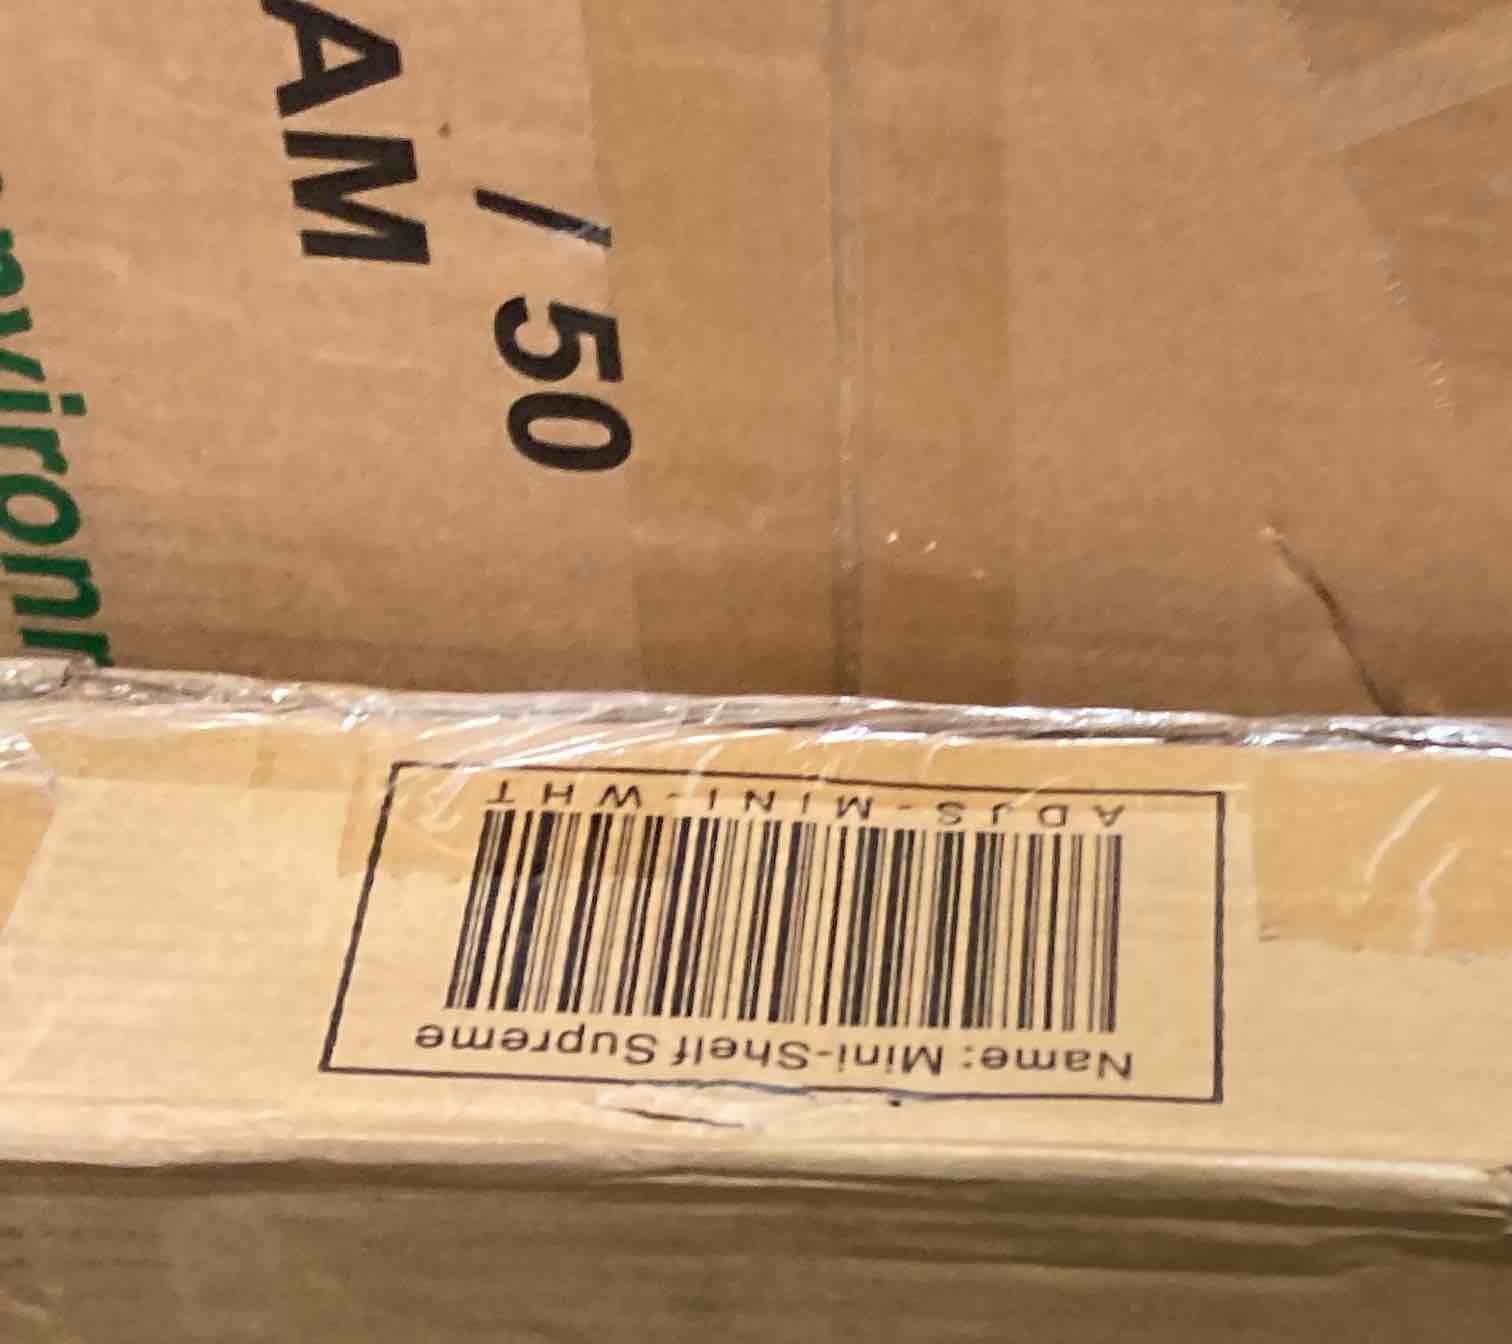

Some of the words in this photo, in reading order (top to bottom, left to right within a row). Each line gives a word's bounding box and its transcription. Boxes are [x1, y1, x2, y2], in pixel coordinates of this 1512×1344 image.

[494, 296, 633, 472] 50
[415, 1023, 659, 1065] Supreme
[674, 1032, 942, 1076] Mini-Shelf
[963, 1045, 1134, 1080] Name:
